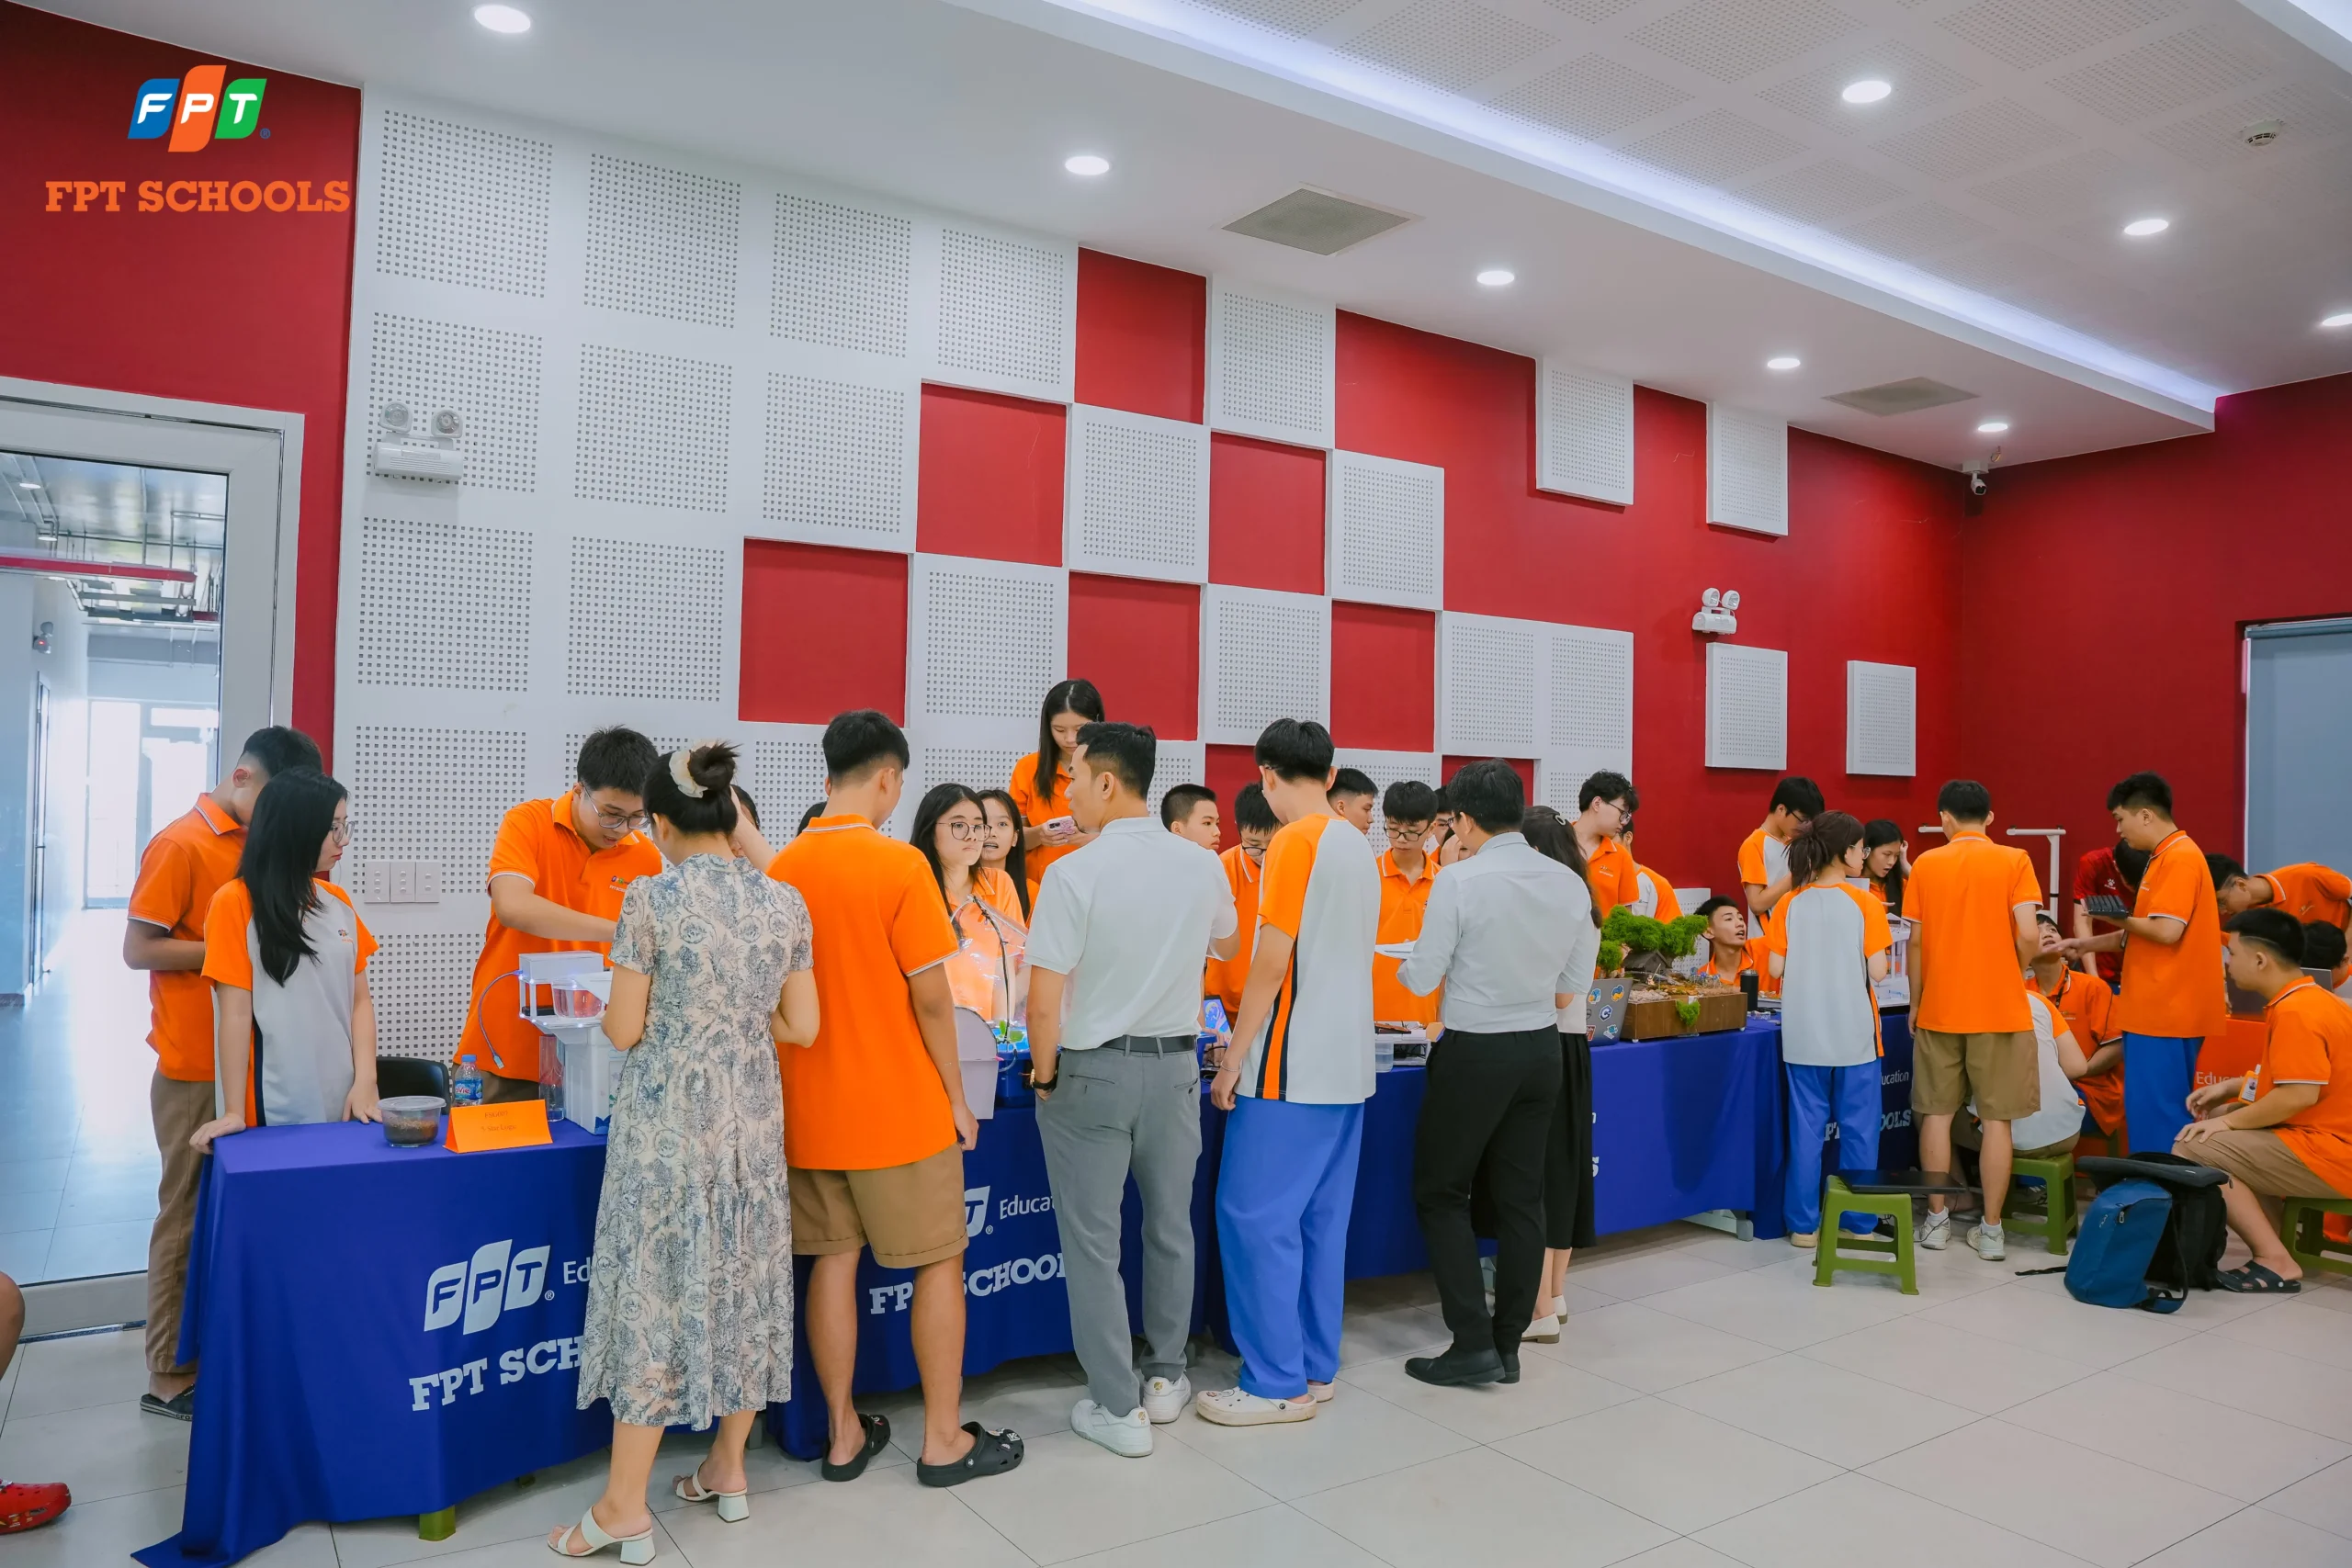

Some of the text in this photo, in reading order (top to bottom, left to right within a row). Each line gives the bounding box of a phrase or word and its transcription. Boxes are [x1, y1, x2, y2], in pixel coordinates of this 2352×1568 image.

[1882, 1070, 1909, 1085] ucation
[1000, 1195, 1055, 1220] Educa
[869, 1280, 914, 1314] FP
[409, 1358, 488, 1411] FPT
